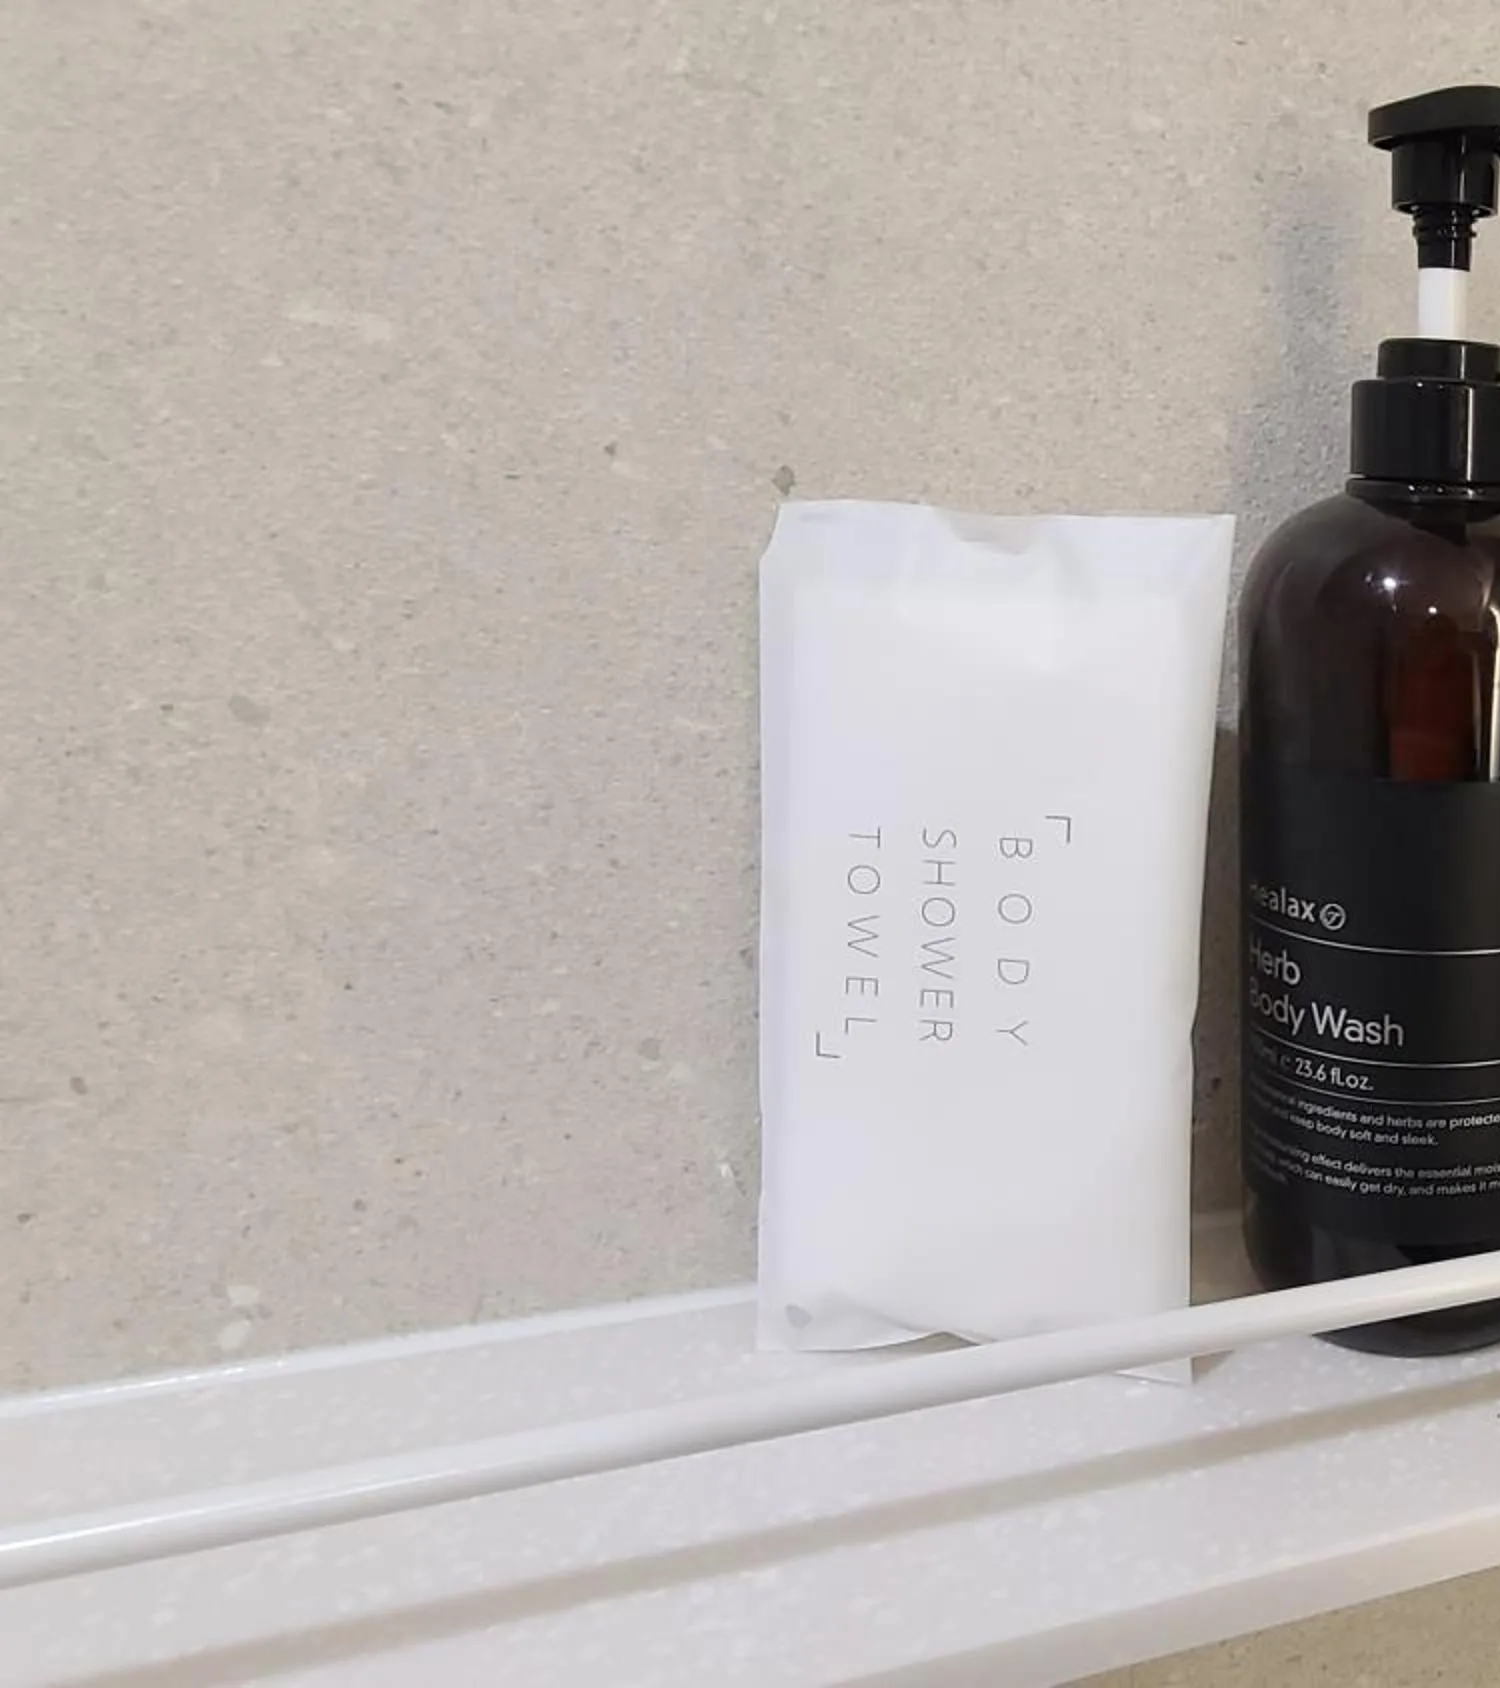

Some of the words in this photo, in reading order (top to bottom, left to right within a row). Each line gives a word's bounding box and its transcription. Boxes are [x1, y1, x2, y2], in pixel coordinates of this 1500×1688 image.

[844, 826, 882, 1035] TOWEL
[919, 826, 958, 1042] SHOWER
[995, 836, 1034, 1047] BODY
[1311, 1001, 1405, 1047] Wash
[1294, 1056, 1327, 1083] 23.6
[1316, 1119, 1347, 1139] body
[1349, 1129, 1373, 1143] soft
[1374, 1132, 1399, 1145] and
[1359, 1113, 1385, 1127] and
[1386, 1113, 1423, 1129] herbs
[1425, 1119, 1447, 1129] are
[1311, 1153, 1343, 1171] effect
[1344, 1160, 1393, 1178] delivers
[1394, 1167, 1415, 1179] the
[1417, 1164, 1473, 1179] essential
[1325, 1174, 1358, 1193] easily
[1359, 1182, 1381, 1196] get
[1408, 1184, 1434, 1197] and
[1436, 1182, 1477, 1196] makes
